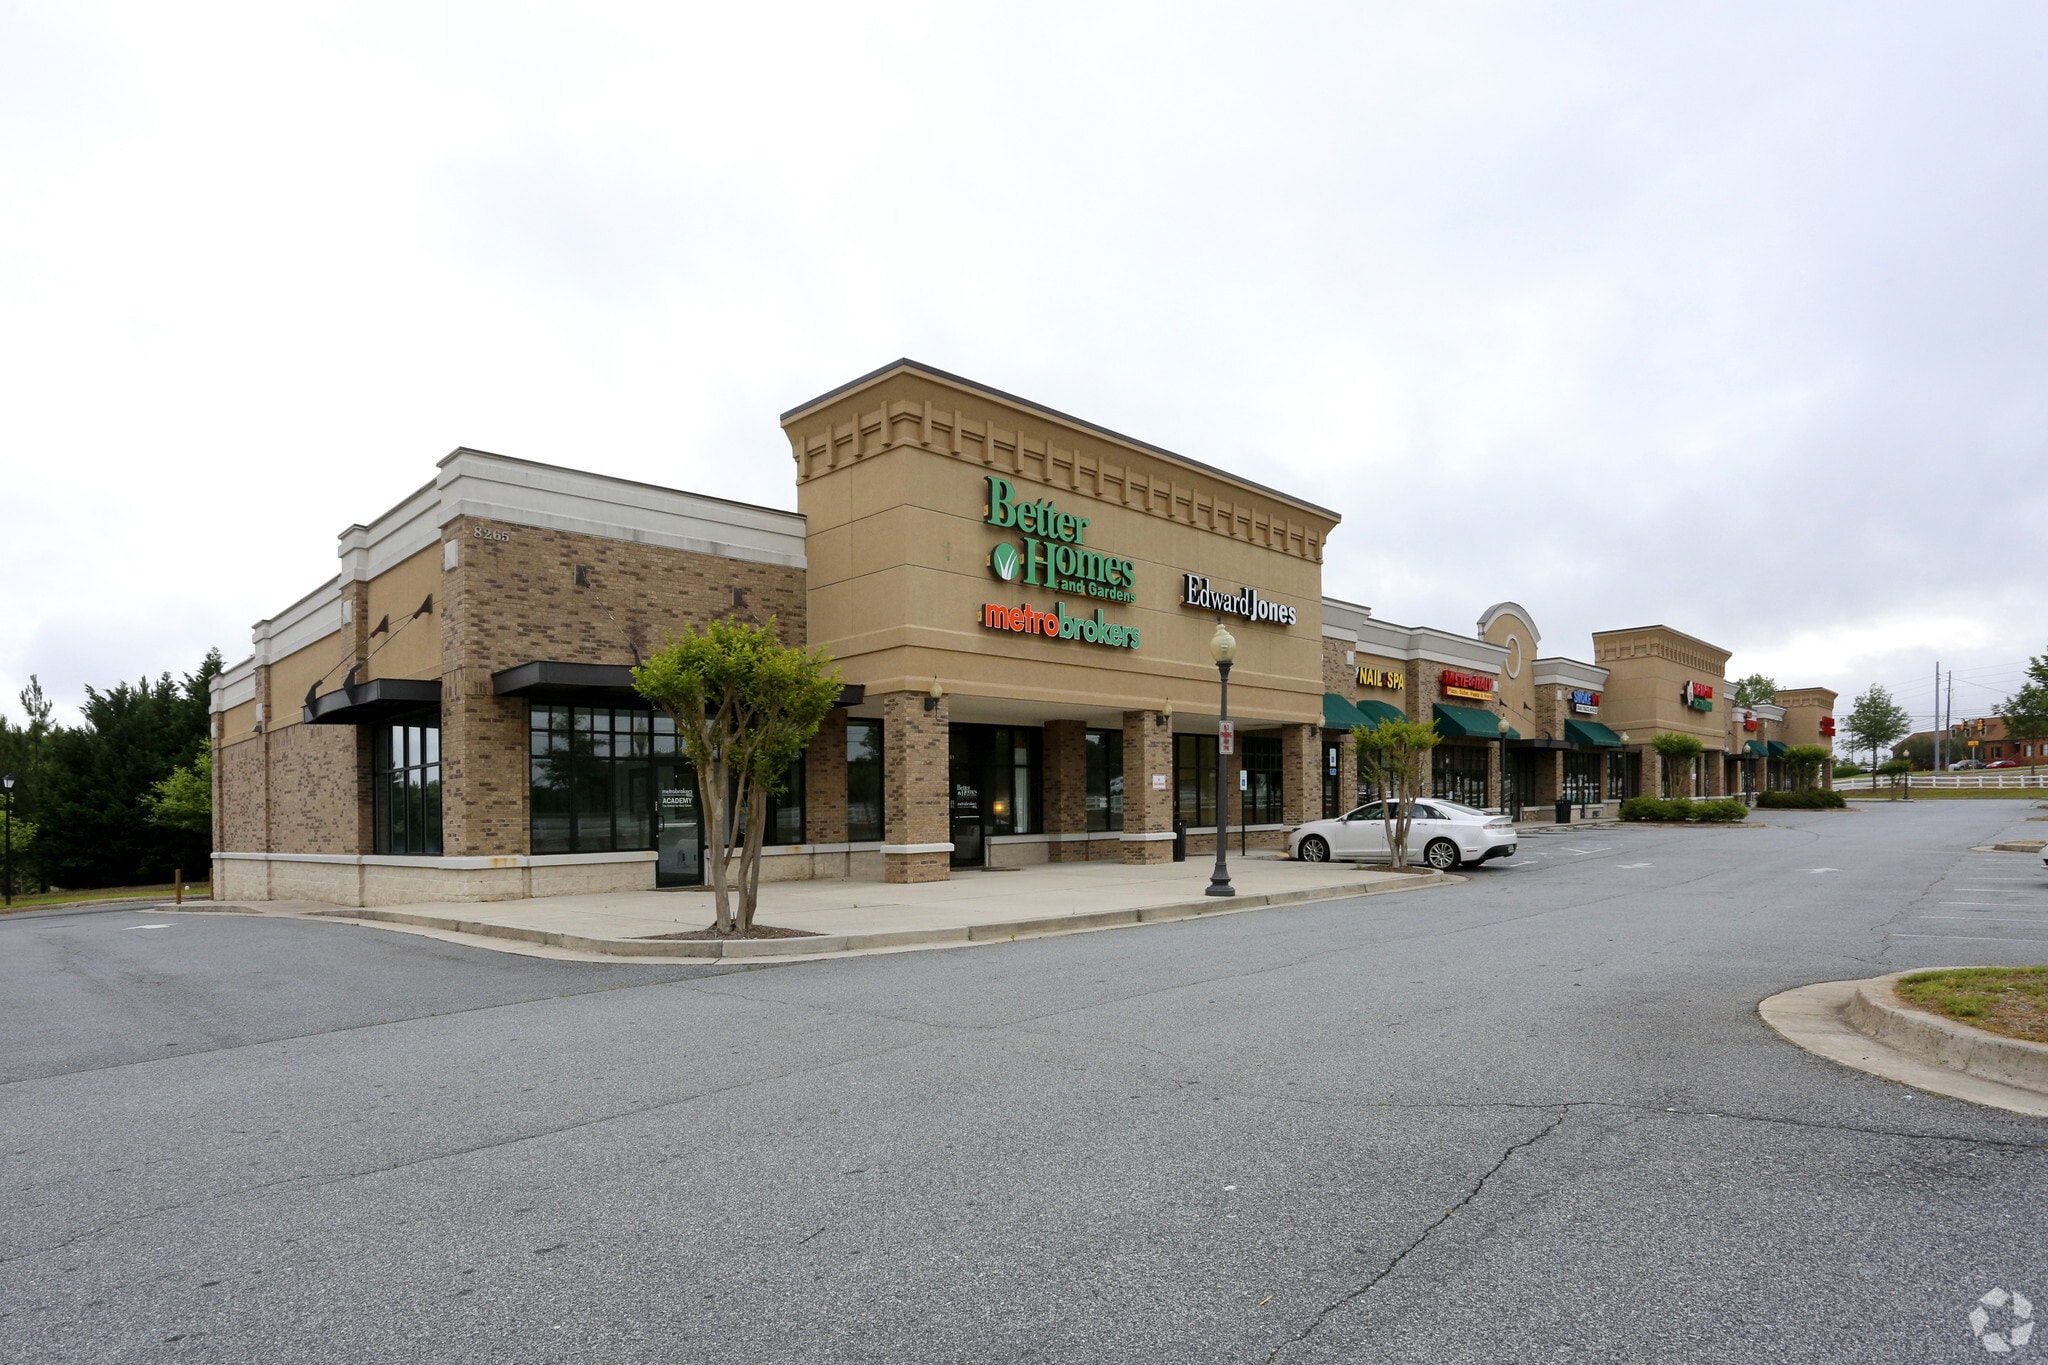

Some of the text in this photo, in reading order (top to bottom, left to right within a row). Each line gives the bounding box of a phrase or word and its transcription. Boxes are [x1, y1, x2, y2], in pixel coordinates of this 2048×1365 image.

[985, 475, 1091, 546] Better
[473, 525, 510, 542] 8265
[1021, 536, 1136, 589] Homes
[1060, 579, 1137, 604] and Gardens
[1185, 573, 1298, 626] Edward Jones
[984, 601, 1142, 650] metrobrokers
[1359, 667, 1383, 687] NAIL
[1386, 671, 1405, 690] SPA
[1474, 676, 1493, 691] ITALY
